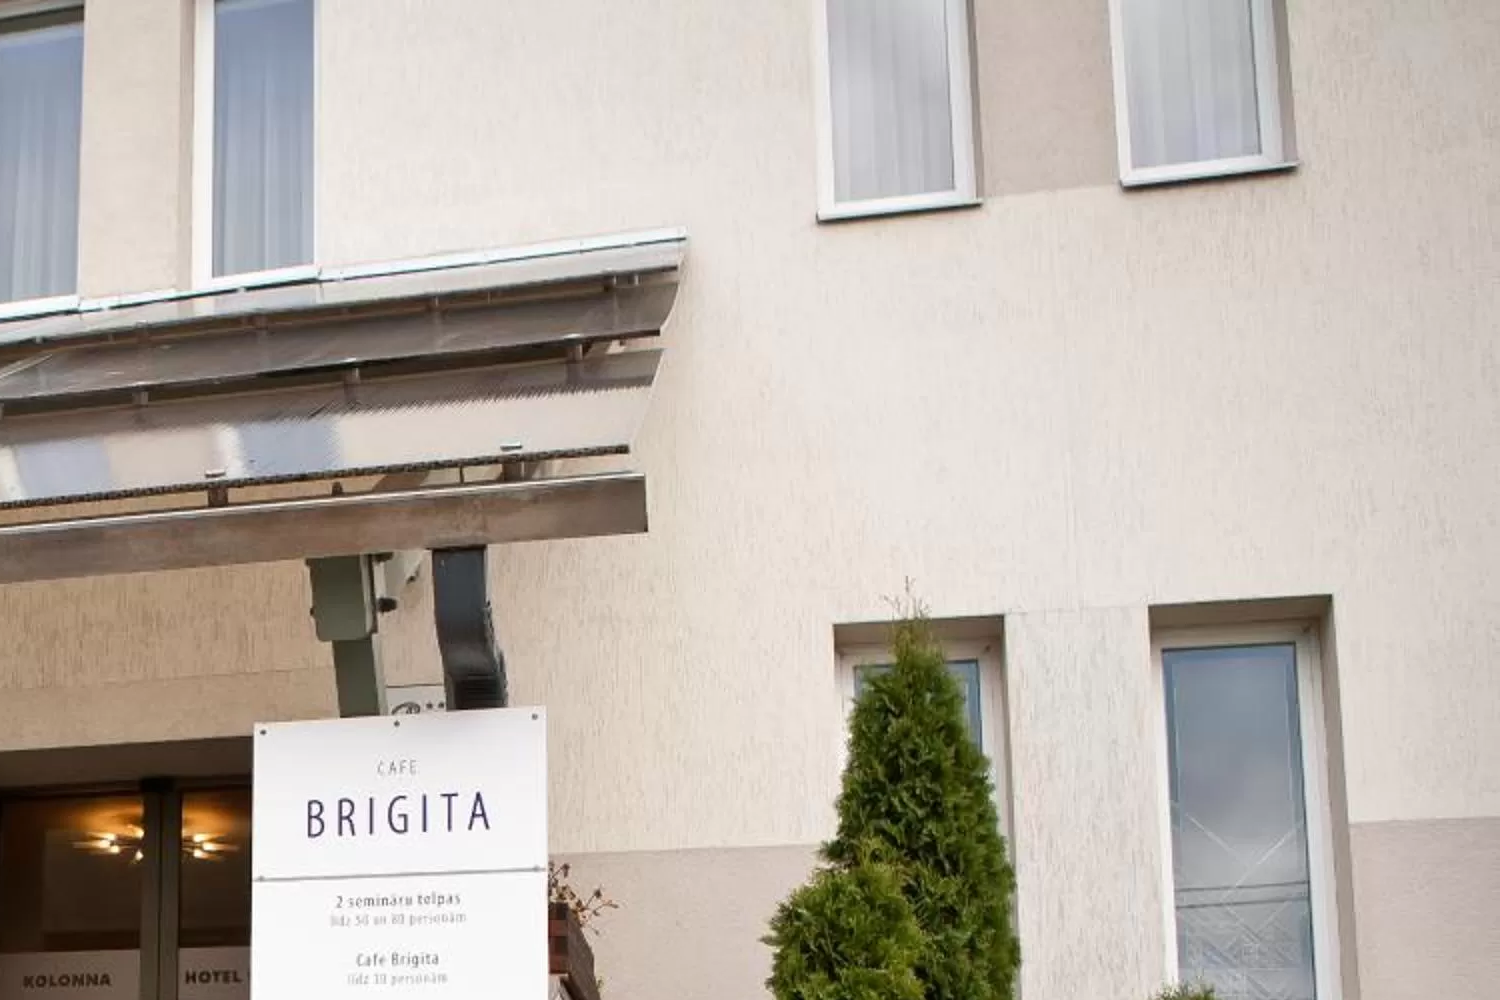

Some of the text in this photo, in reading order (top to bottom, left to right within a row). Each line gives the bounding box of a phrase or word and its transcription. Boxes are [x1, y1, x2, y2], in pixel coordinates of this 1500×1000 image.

[376, 759, 417, 776] CAFE
[307, 791, 490, 839] BRIGITA
[335, 895, 344, 909] 2
[416, 891, 461, 908] telpas
[391, 951, 439, 968] Brigita
[22, 969, 244, 989] KOLONNA HOTEL
